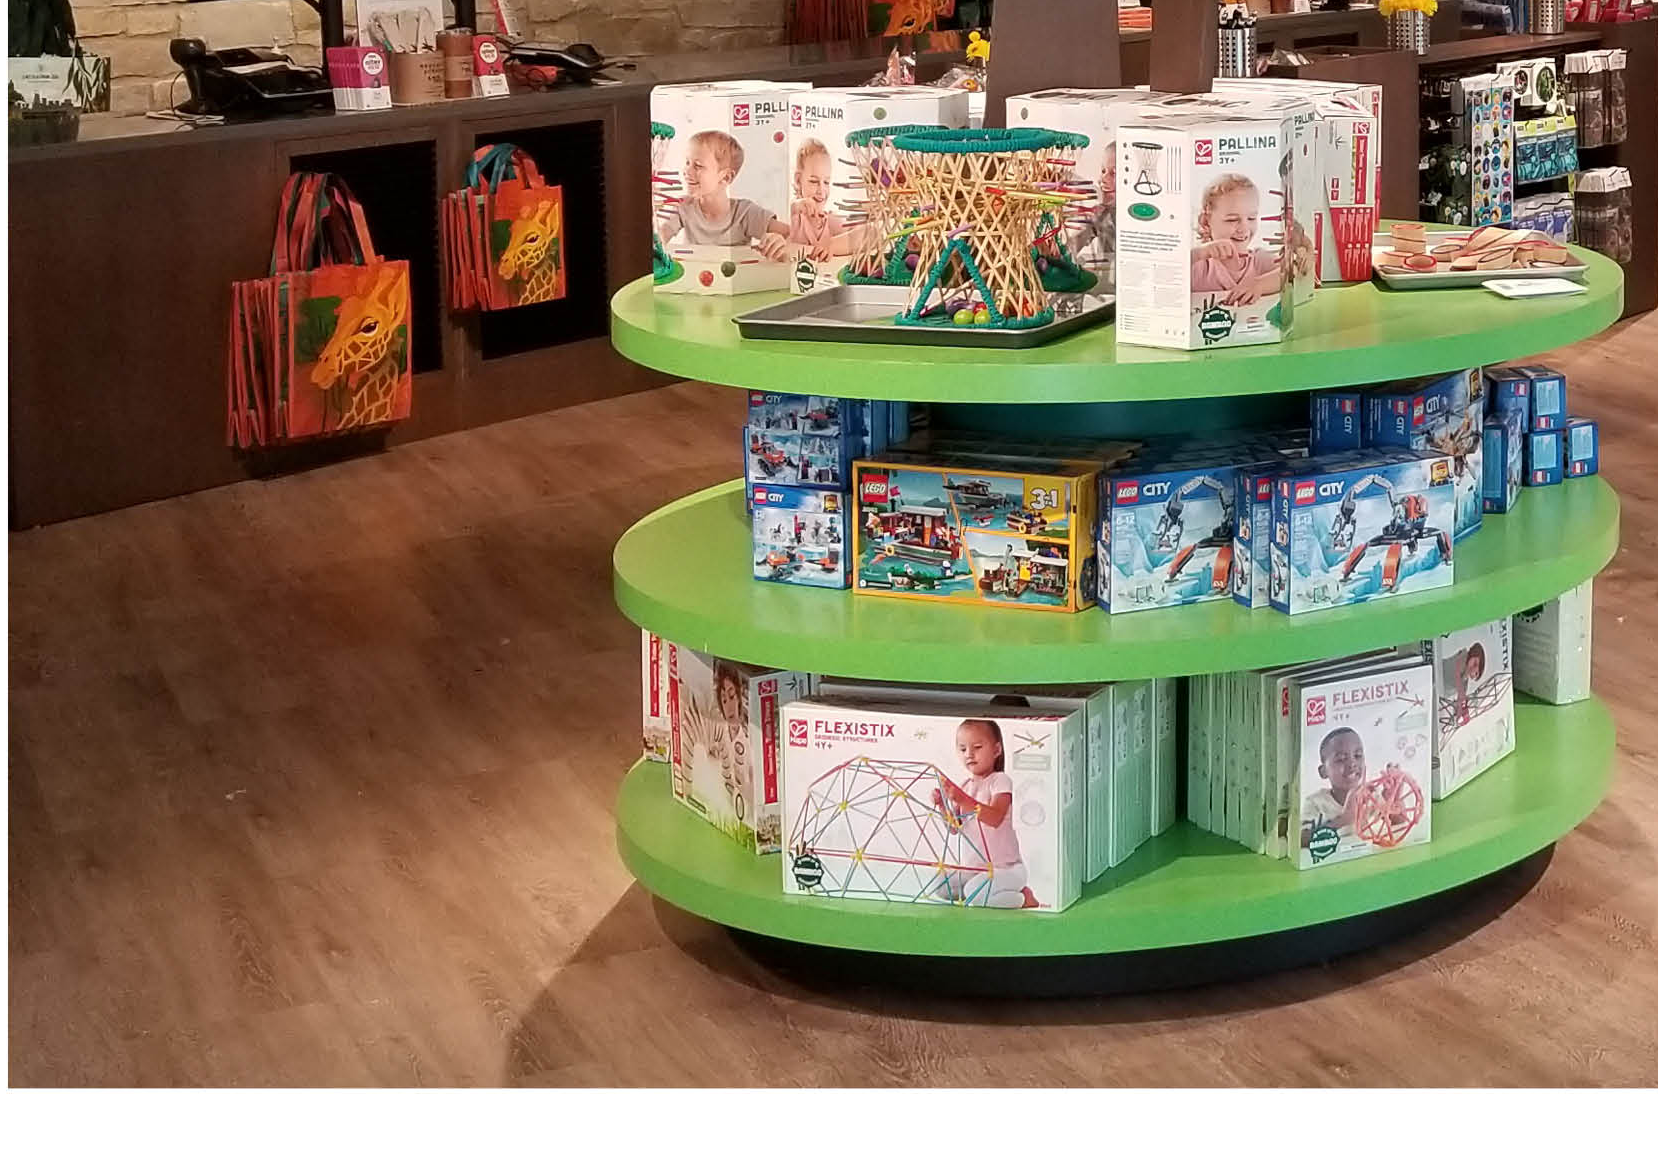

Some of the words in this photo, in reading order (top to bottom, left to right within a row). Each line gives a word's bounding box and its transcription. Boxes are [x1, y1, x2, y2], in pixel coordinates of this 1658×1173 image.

[805, 106, 844, 119] PALLINA
[1218, 136, 1277, 150] PALLINA
[1426, 394, 1441, 414] CITY
[864, 483, 887, 495] LEGO
[1116, 486, 1138, 498] LEGO
[1142, 481, 1171, 496] CITY
[1295, 486, 1316, 499] LEGO
[1319, 480, 1345, 497] CITY
[767, 492, 784, 503] CITY
[1332, 680, 1409, 706] FLEXISTIX
[814, 719, 895, 738] FLEXISTIX
[814, 741, 833, 750] 4Y+
